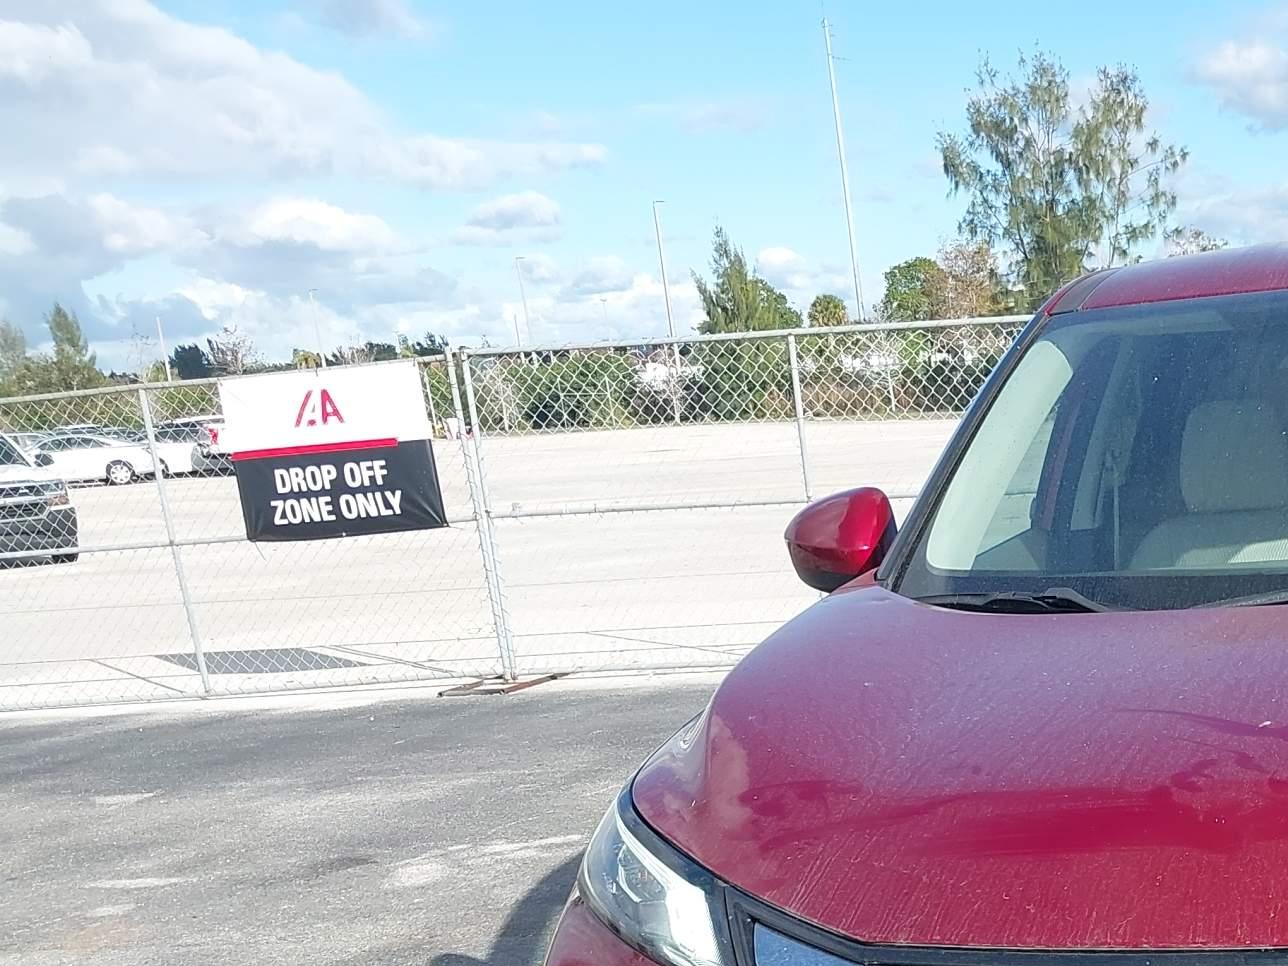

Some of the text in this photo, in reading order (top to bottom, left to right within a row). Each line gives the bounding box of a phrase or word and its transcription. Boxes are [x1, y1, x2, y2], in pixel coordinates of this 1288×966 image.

[273, 459, 388, 494] DROP OFF
[270, 489, 402, 526] ZONE ONLY
